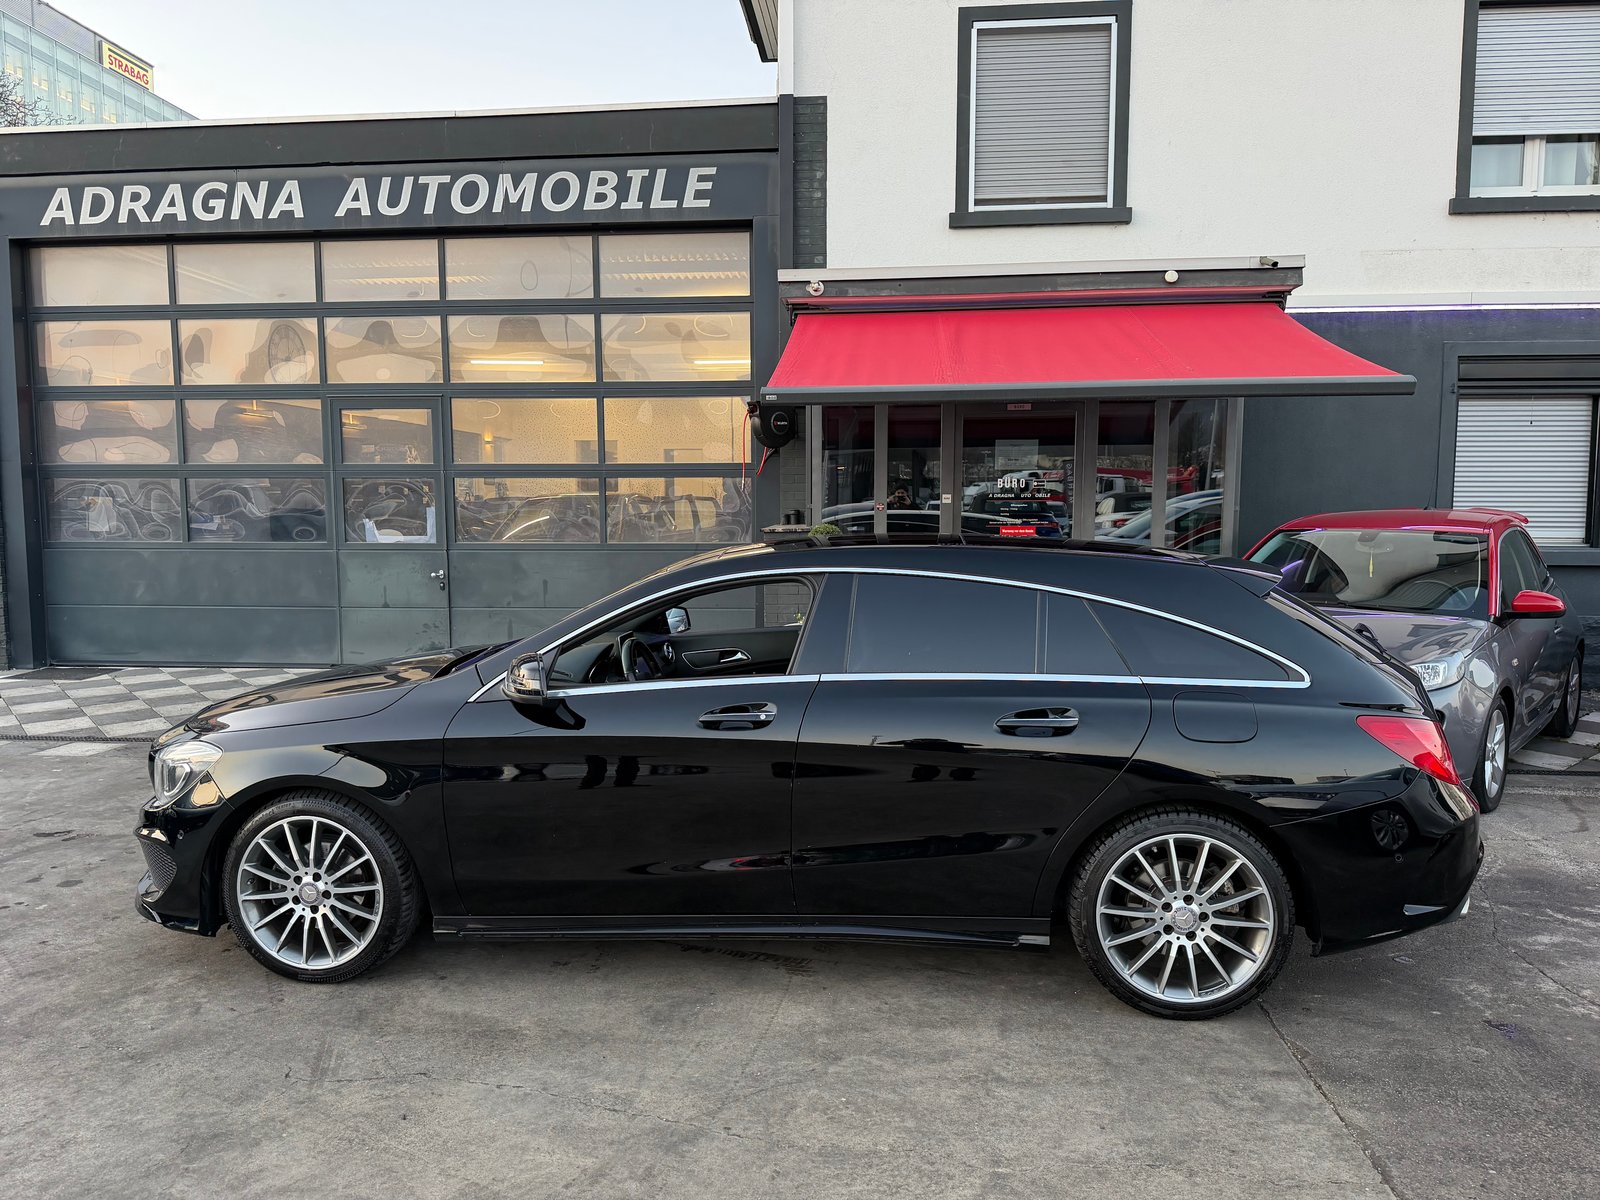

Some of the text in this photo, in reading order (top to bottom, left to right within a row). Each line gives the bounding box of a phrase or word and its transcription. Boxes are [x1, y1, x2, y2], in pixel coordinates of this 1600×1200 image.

[107, 53, 150, 86] STRABAG
[40, 166, 717, 226] ADRAGNA AUTOMOBILE
